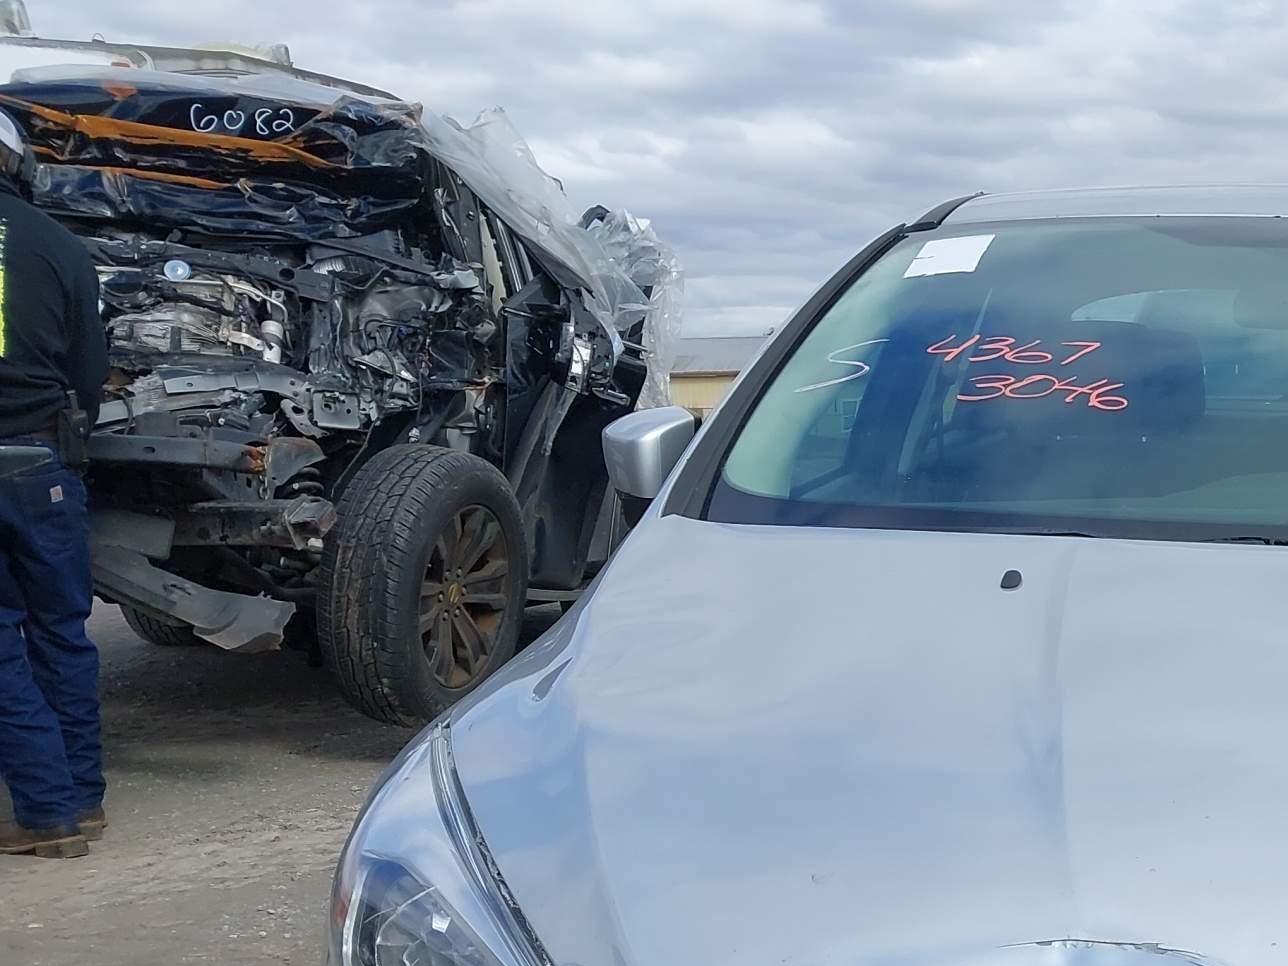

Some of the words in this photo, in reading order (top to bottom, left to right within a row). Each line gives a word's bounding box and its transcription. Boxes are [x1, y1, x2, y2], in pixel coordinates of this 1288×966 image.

[190, 103, 295, 135] 6082
[926, 334, 1101, 365] 4367
[956, 374, 1129, 410] 3046
